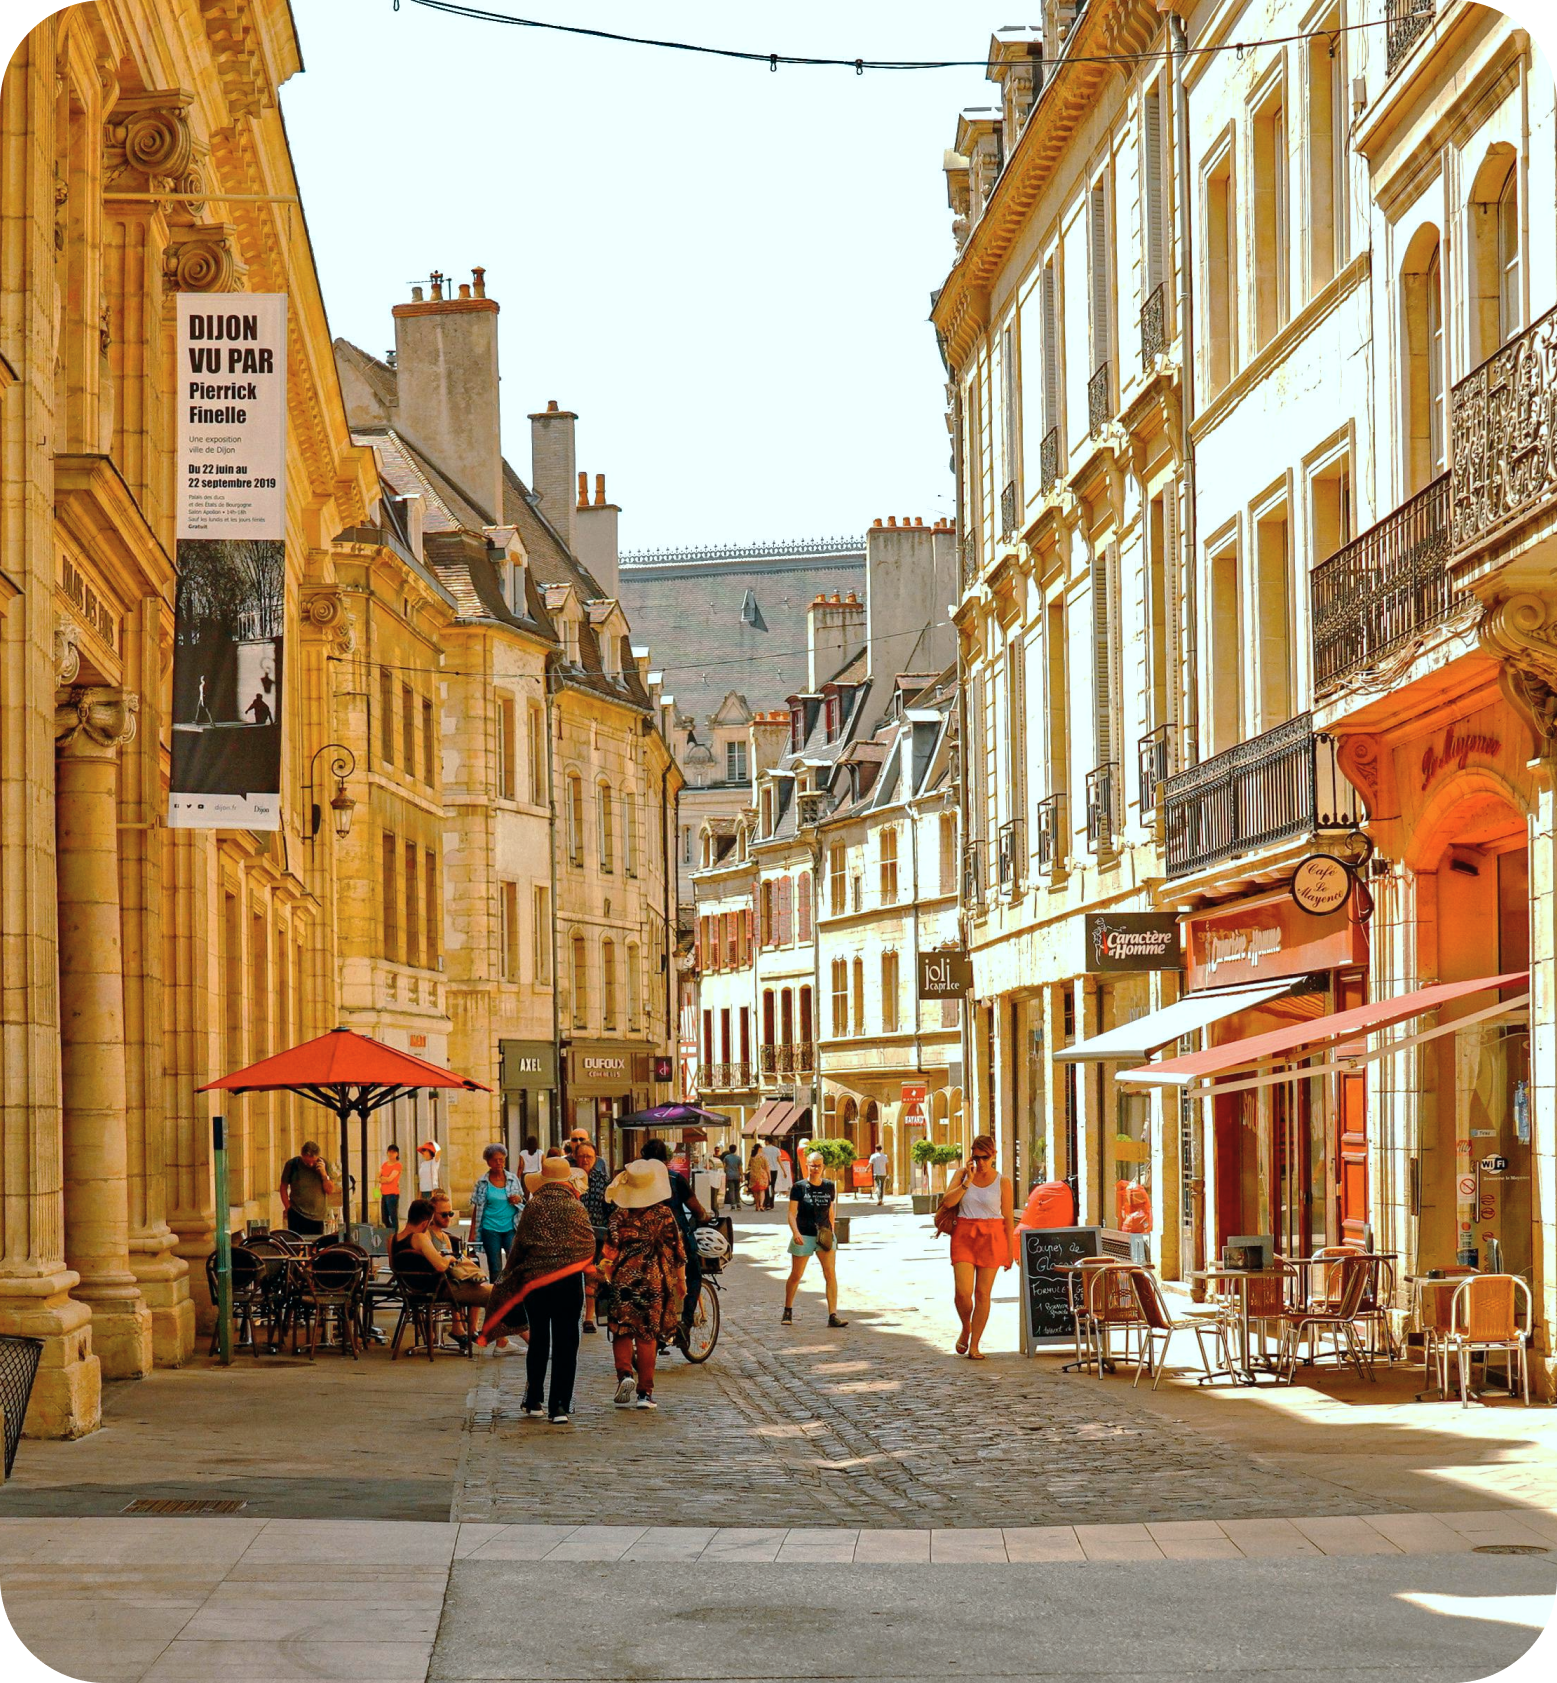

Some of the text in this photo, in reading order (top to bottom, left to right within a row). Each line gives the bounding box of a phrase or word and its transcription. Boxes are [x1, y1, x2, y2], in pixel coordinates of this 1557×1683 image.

[189, 314, 258, 341] DIJON
[189, 348, 274, 374] VU PAR
[189, 382, 257, 400] Pierrick
[189, 406, 247, 424] Finelle
[205, 436, 242, 444] exposition
[189, 446, 236, 455] ville de Dijon
[188, 464, 248, 475] Du 22 juin au
[188, 478, 276, 489] 22 septembre 2019
[214, 804, 270, 814] dijon.fr Dijon
[1306, 863, 1338, 881] Café
[1313, 881, 1329, 892] Le
[1297, 887, 1344, 908] Mayence
[1107, 930, 1172, 948] Caractère
[924, 958, 951, 991] joli
[519, 1057, 542, 1072] AXEL
[584, 1057, 626, 1069] DUFOUX
[1069, 1242, 1085, 1254] de
